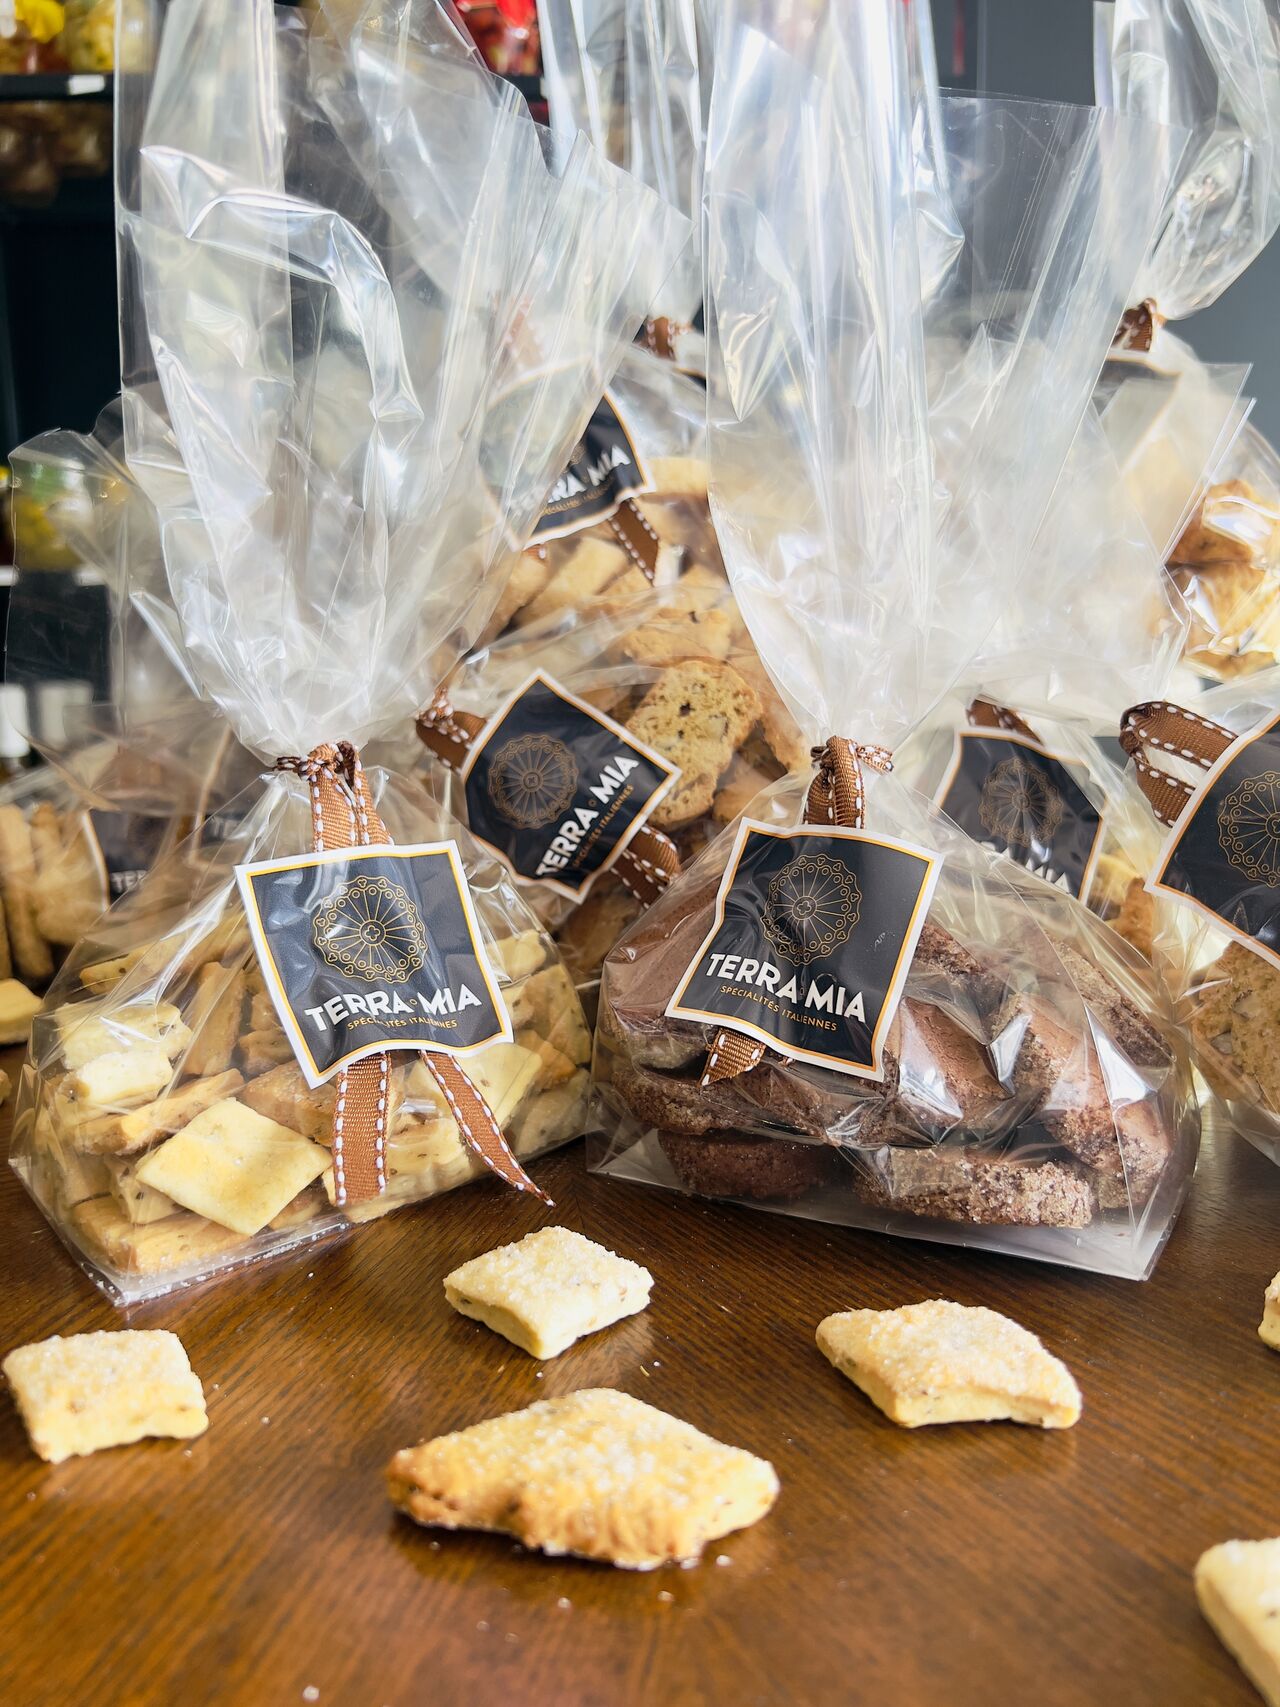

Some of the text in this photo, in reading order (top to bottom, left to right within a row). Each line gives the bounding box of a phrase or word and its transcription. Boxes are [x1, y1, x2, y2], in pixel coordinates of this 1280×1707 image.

[535, 755, 640, 876] TERRA MIA
[304, 983, 482, 1031] TERRA MIA
[706, 953, 866, 1023] TERRA MIA
[719, 985, 838, 1032] SPÉCIALITÉS ITALIENNES
